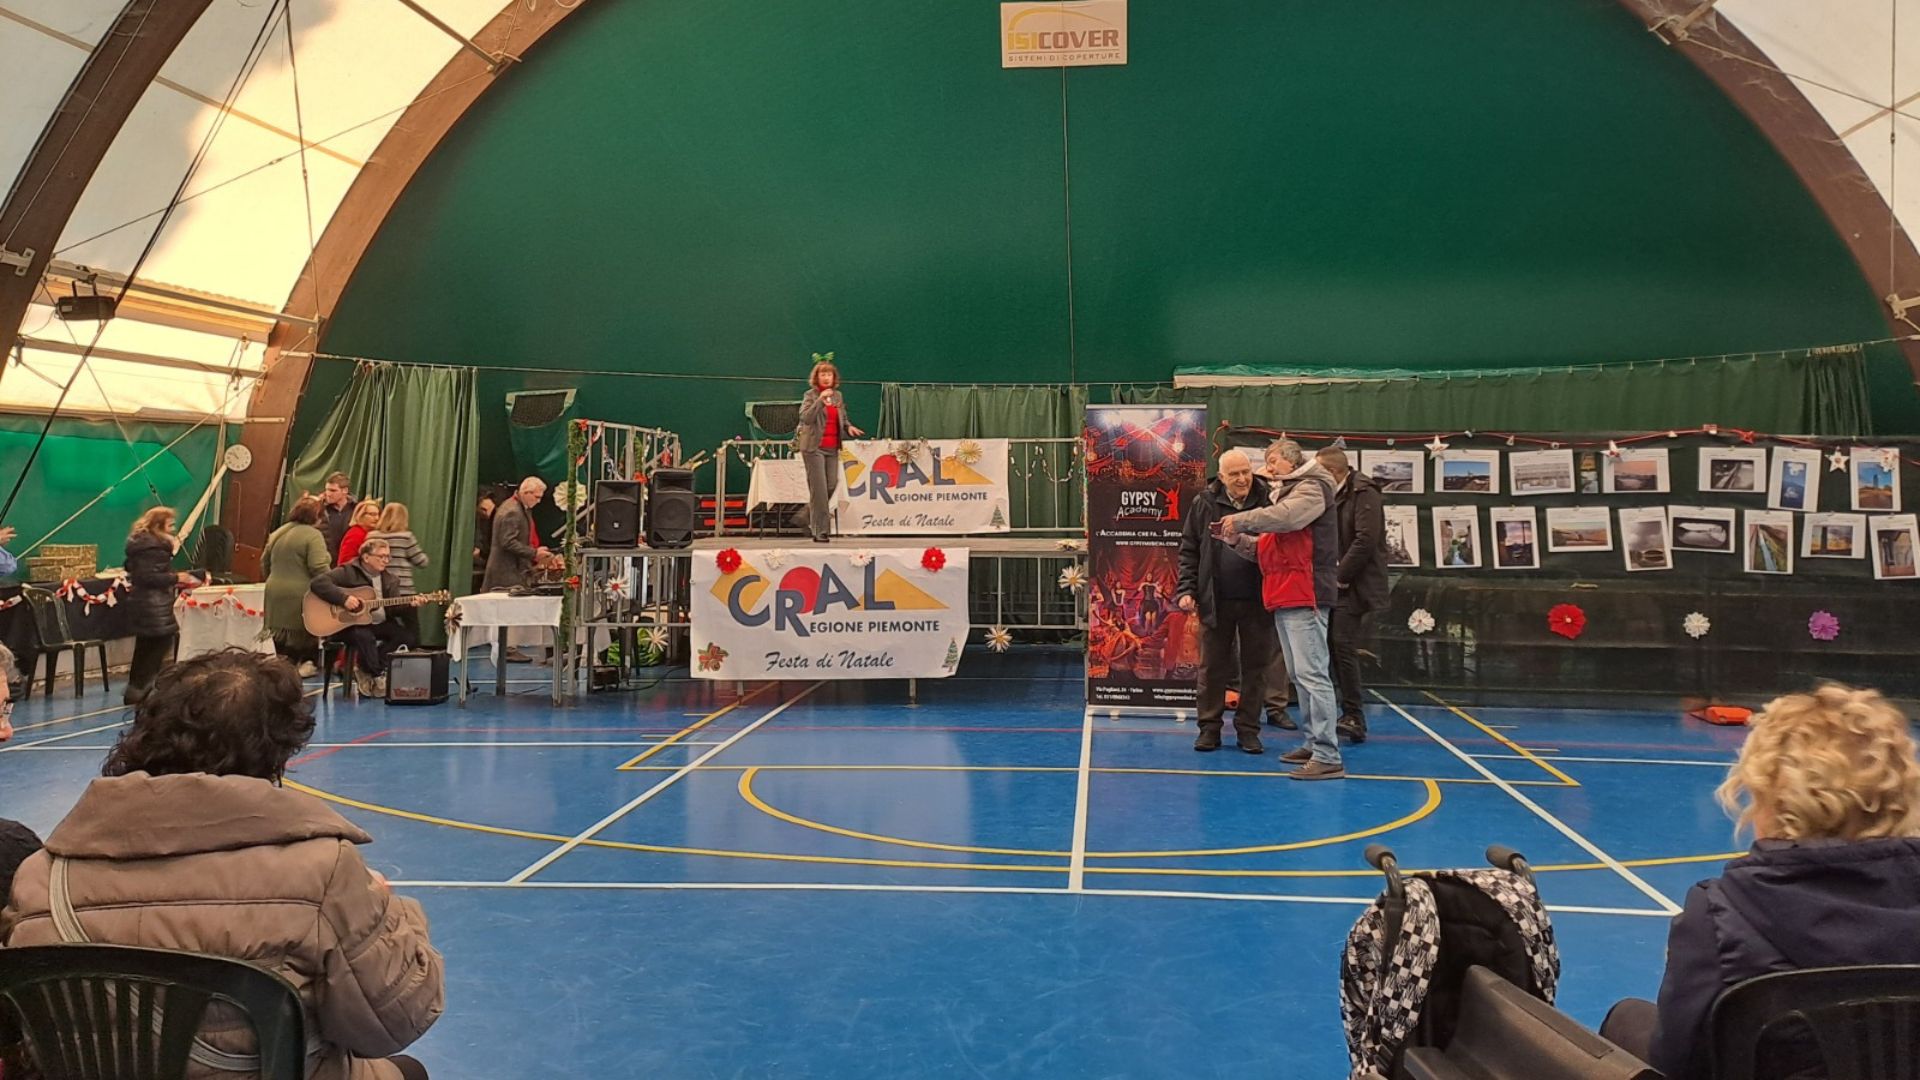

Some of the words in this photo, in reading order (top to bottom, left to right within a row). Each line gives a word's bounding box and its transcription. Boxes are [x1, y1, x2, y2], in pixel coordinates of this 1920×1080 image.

[1008, 54, 1046, 62] SISTEMI
[936, 491, 988, 501] PIEMONTE
[1121, 491, 1158, 506] GYPSY
[1115, 505, 1163, 521] Academy
[861, 513, 895, 530] Festa
[899, 514, 911, 527] di
[914, 513, 955, 527] Natale
[727, 556, 896, 637] CRAL
[868, 620, 940, 632] PIEMONTE
[764, 651, 810, 672] Festa
[816, 652, 834, 669] di
[838, 650, 894, 669] Natale
